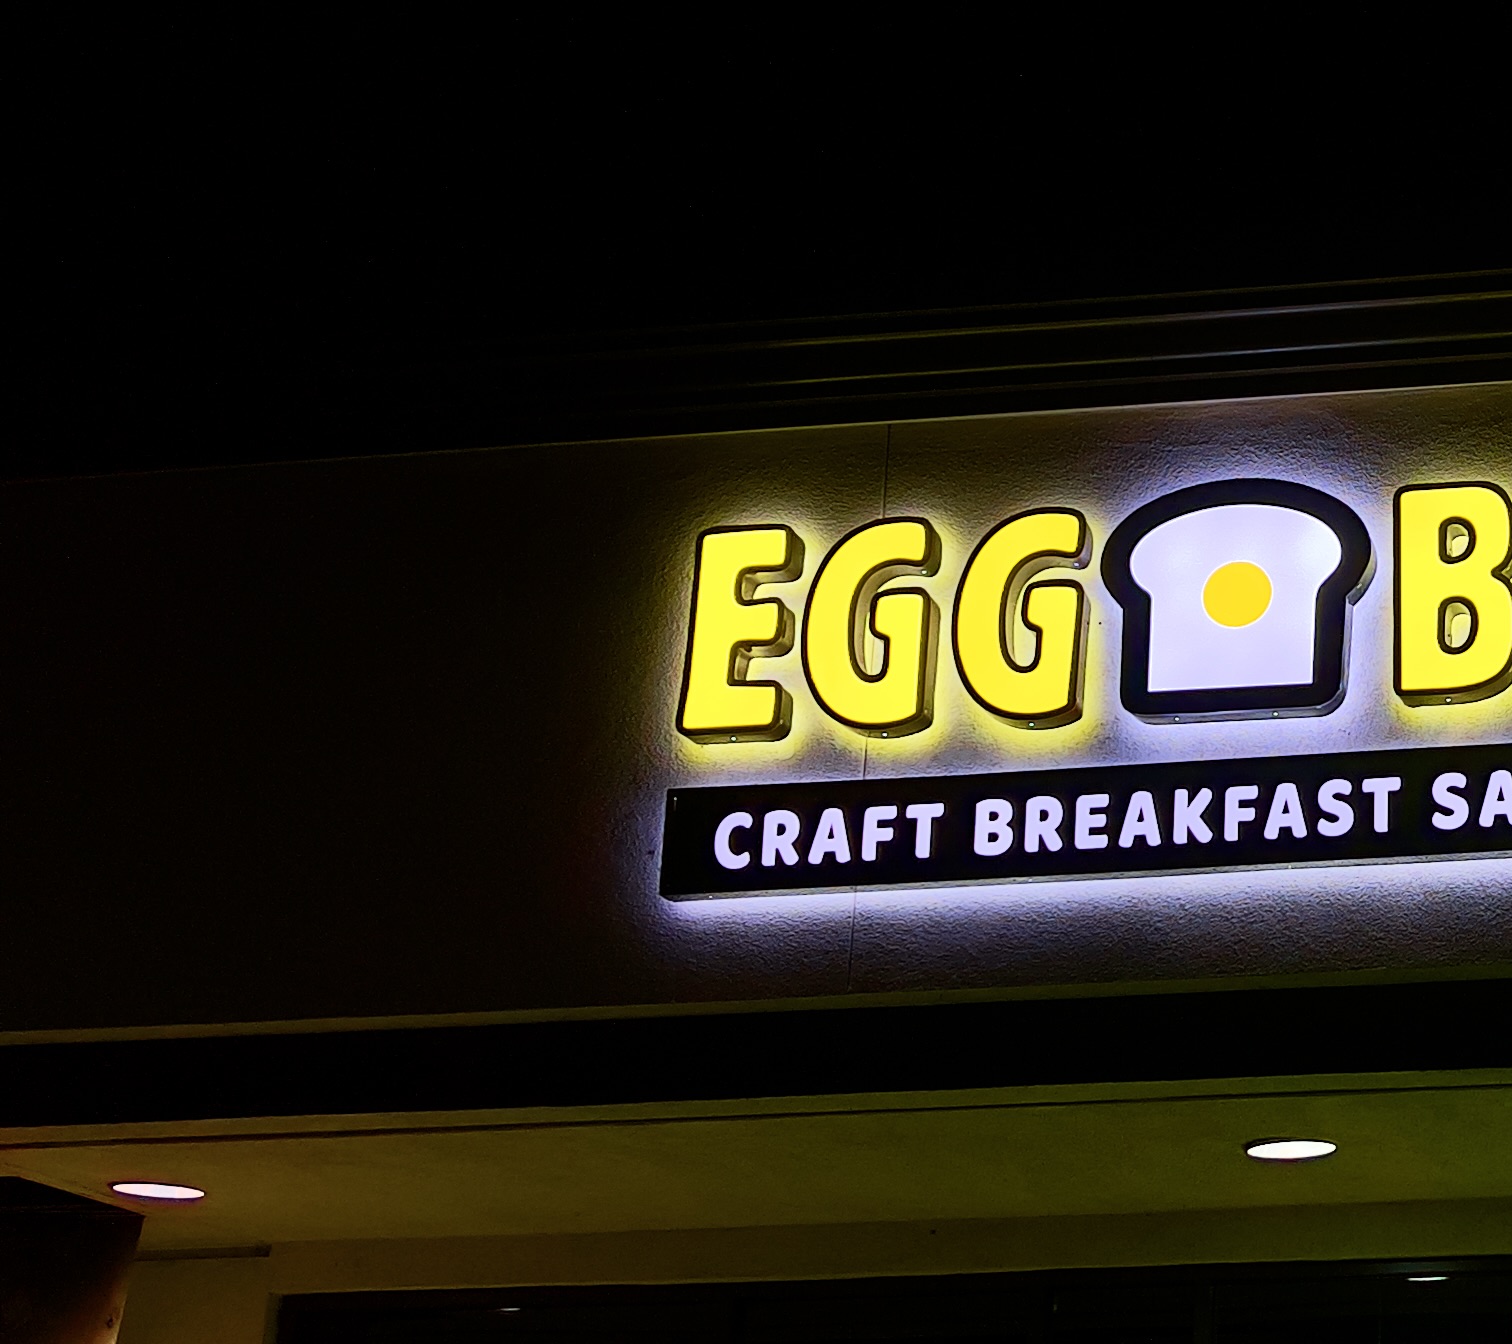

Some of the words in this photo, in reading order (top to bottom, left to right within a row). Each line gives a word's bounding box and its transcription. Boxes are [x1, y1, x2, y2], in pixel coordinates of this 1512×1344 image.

[676, 507, 1092, 744] EGG
[714, 803, 944, 870] CRAFT
[973, 777, 1401, 857] BREAKFAST
